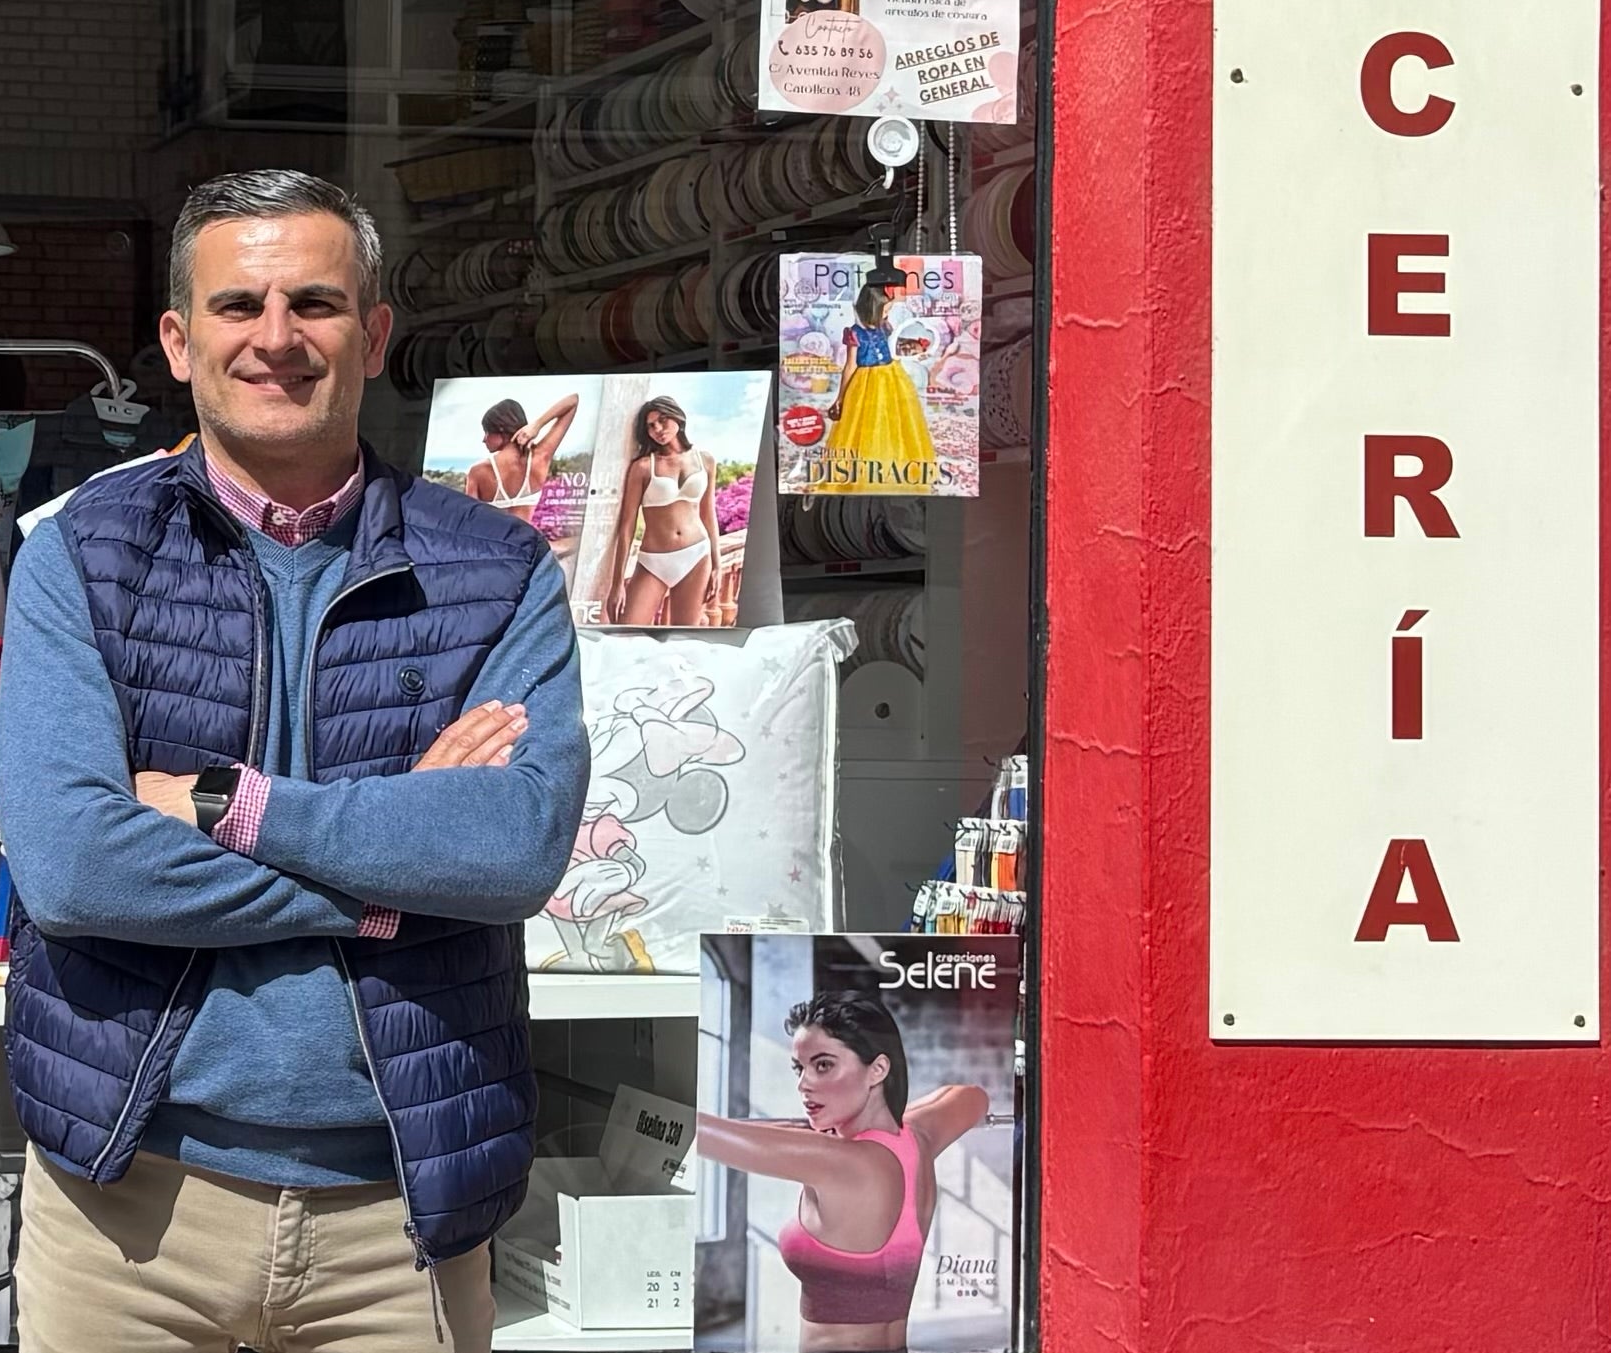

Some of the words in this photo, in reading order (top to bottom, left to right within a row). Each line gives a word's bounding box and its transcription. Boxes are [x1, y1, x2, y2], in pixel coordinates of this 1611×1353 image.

[931, 9, 945, 19] de
[795, 45, 819, 57] 635
[822, 46, 837, 57] 76
[840, 47, 855, 58] 89
[859, 48, 874, 59] 56
[894, 36, 976, 70] ARREGLOS
[980, 31, 1000, 48] DE
[785, 64, 839, 78] Avenida
[917, 63, 962, 85] ROPA
[965, 55, 986, 72] EN
[919, 74, 991, 104] GENERAL
[814, 263, 955, 290] Patnes
[805, 459, 955, 485] DISFRACES
[936, 1254, 998, 1275] Diana
